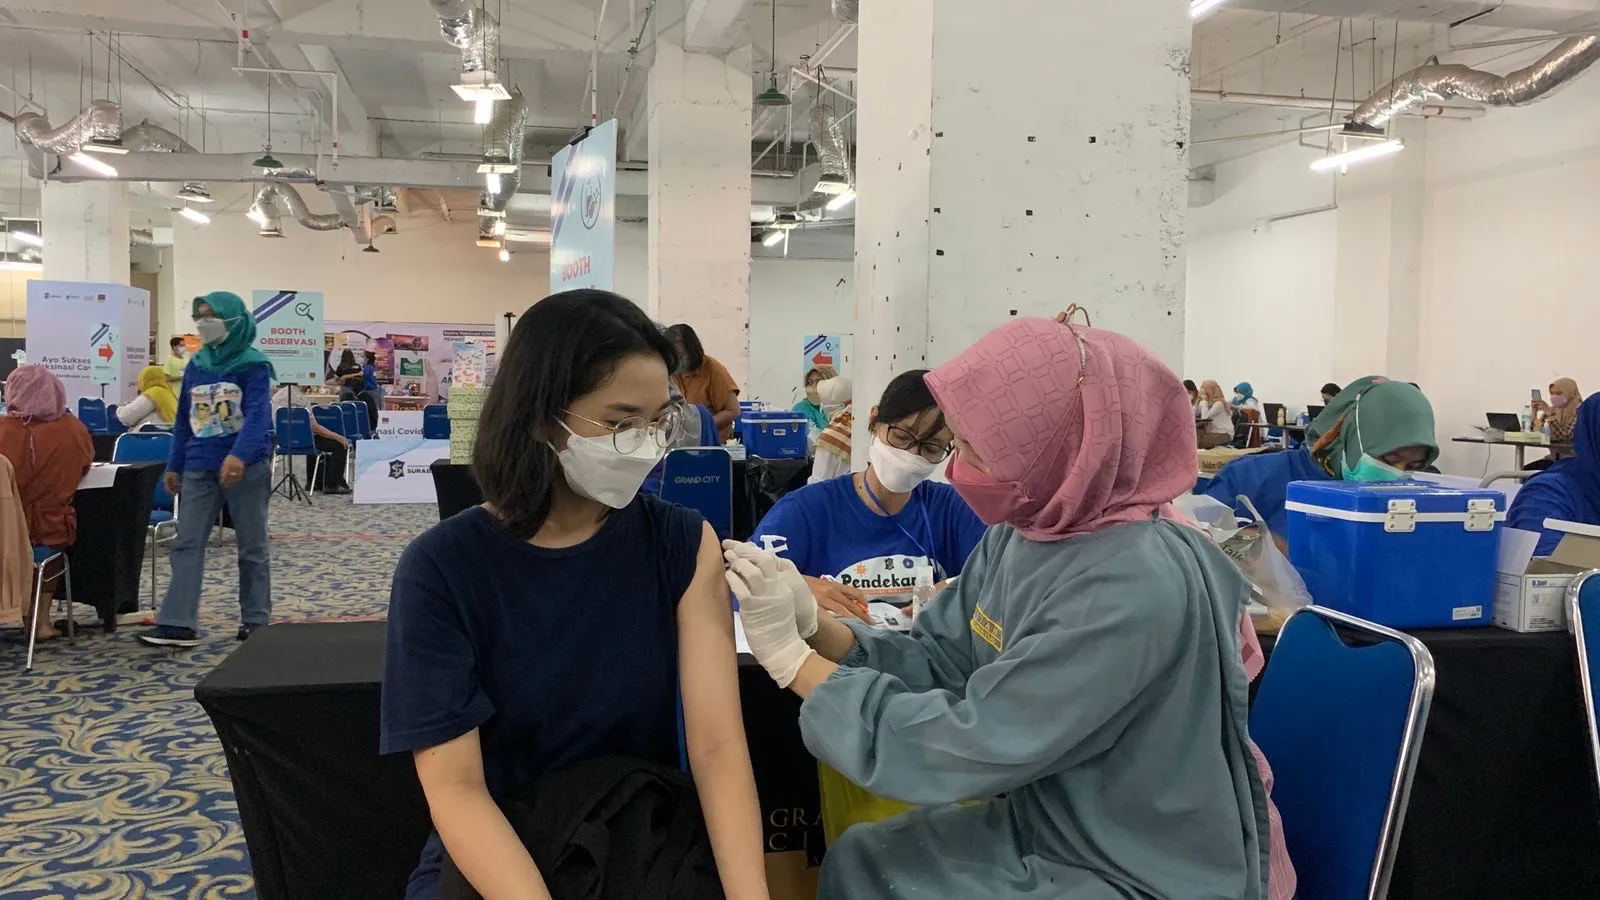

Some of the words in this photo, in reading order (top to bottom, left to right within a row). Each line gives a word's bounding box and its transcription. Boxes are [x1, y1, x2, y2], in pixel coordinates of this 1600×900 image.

[562, 255, 591, 281] BOOTH
[271, 327, 306, 336] BOOTH
[260, 337, 317, 346] OBSERVASI
[42, 356, 59, 364] Ayo
[674, 476, 702, 484] GRAND
[702, 475, 721, 483] CITY
